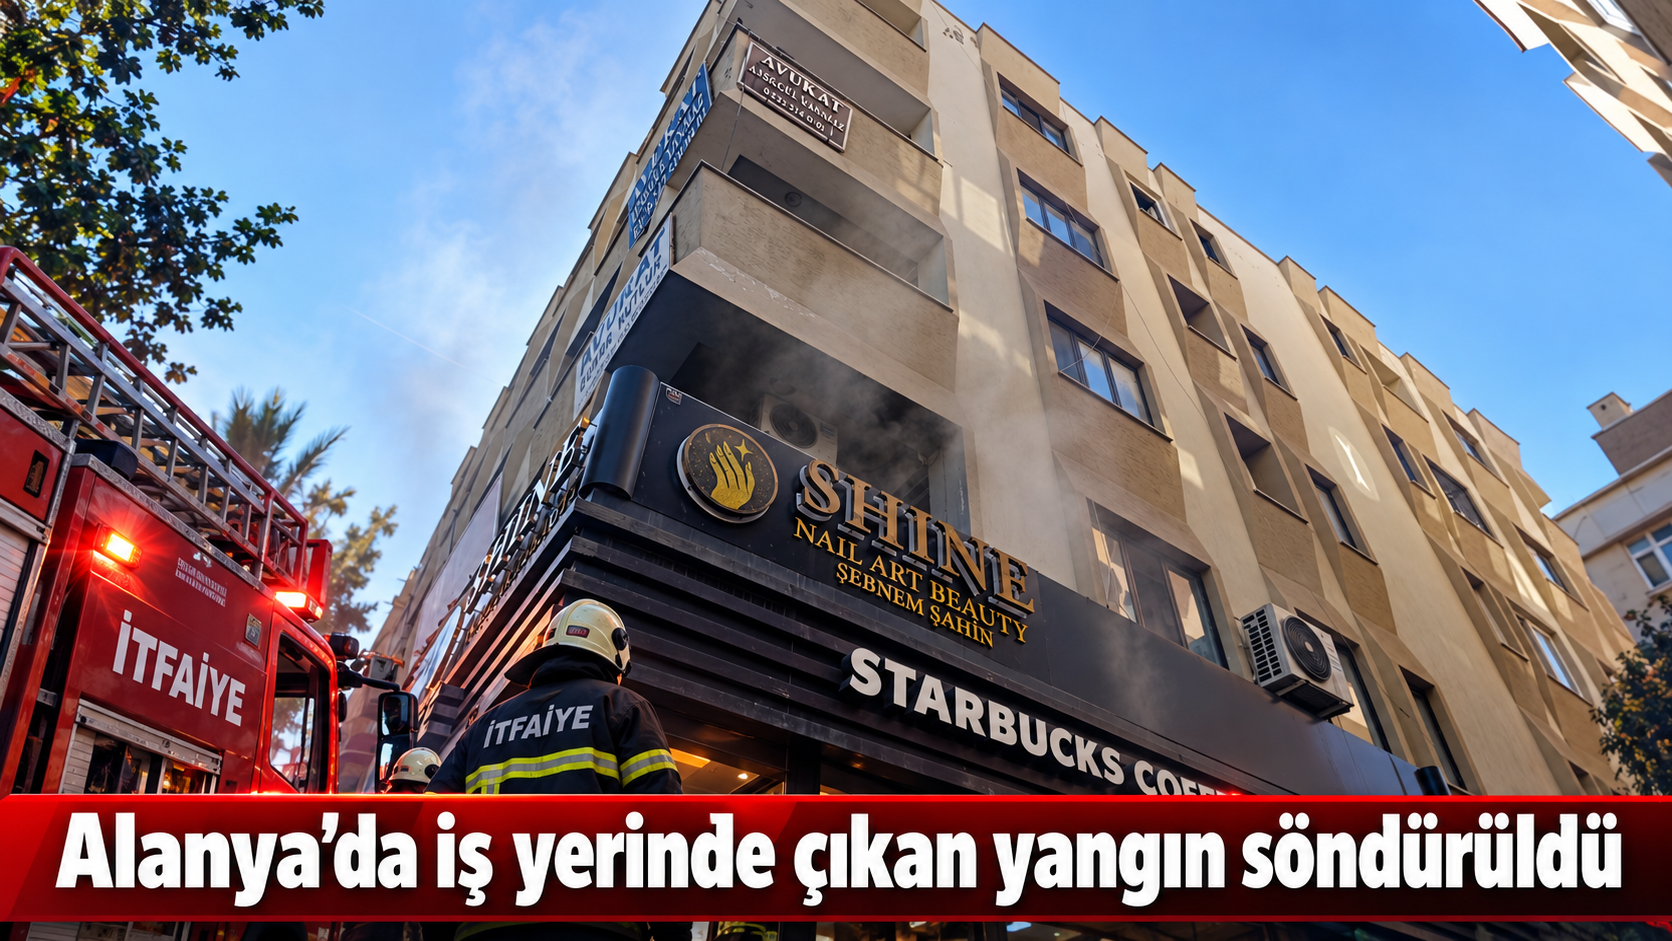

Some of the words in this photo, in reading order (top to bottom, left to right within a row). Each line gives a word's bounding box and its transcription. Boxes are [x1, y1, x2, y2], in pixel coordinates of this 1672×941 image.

[760, 56, 844, 113] AVUKAT
[580, 227, 665, 376] AVUKAT
[793, 517, 863, 566] NAIL
[869, 555, 924, 593] ART
[929, 579, 1029, 644] BEAUTY
[797, 460, 1035, 617] SHINE
[836, 562, 925, 617] ŞEBNEM
[929, 604, 995, 649] ŞAHİN
[112, 609, 246, 727] İTFAİYE
[483, 704, 594, 749] İTFAİYE
[849, 647, 1126, 786] STARBUCKS
